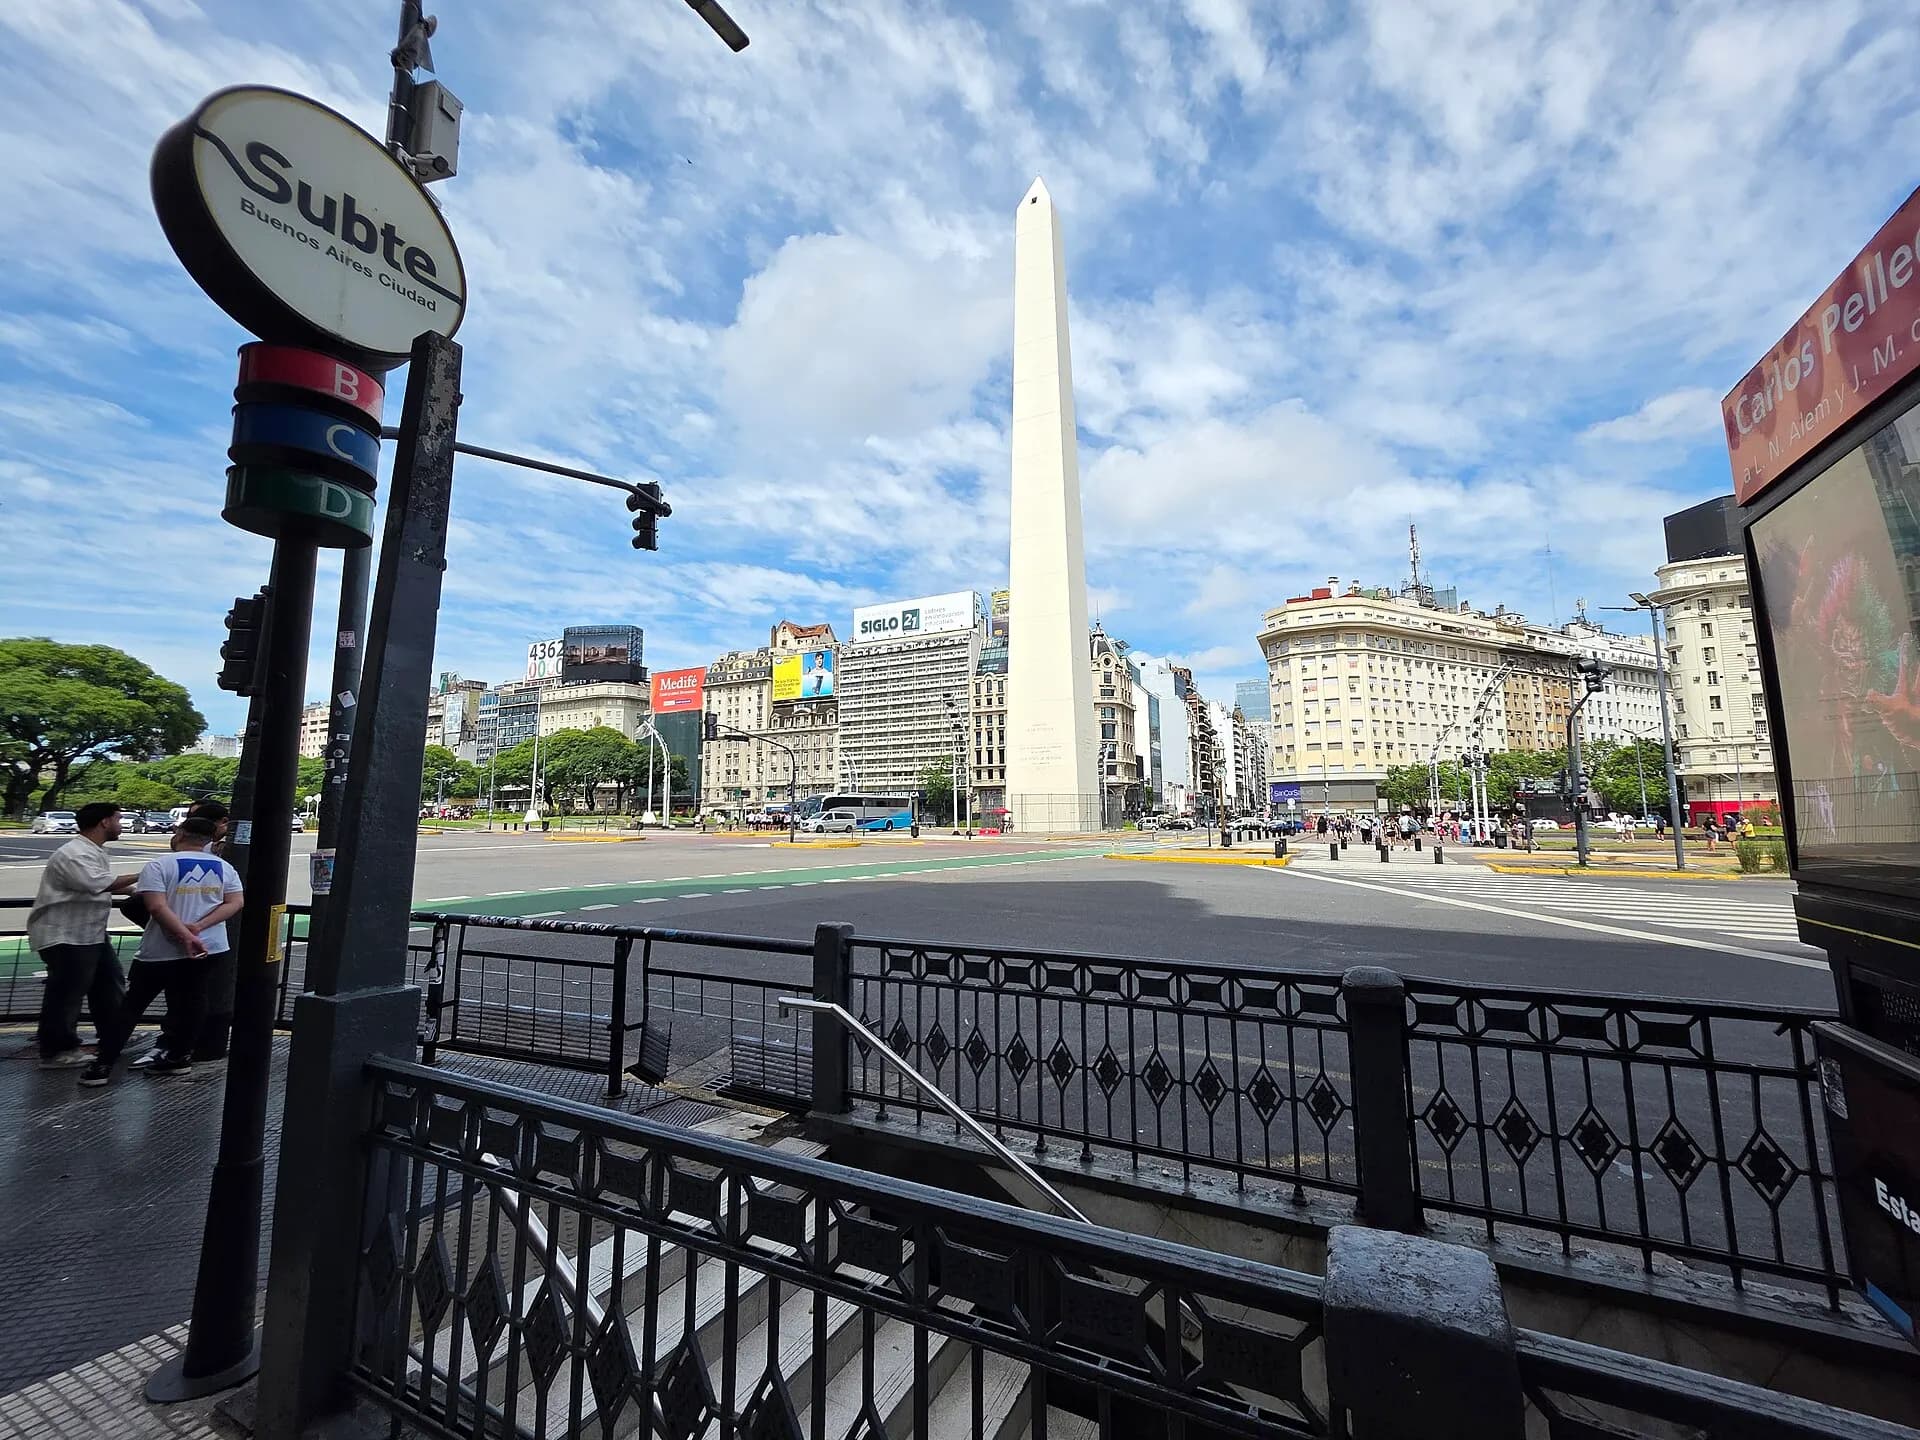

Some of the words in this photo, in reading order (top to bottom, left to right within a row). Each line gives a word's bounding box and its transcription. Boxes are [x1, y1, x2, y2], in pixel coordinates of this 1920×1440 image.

[238, 139, 441, 286] Subte
[240, 197, 319, 250] Buenos
[325, 245, 373, 279] Aires
[378, 272, 437, 312] Ciudad
[1735, 339, 1815, 435] Carlos
[1821, 226, 1920, 355] Pelle
[335, 363, 359, 401] B
[1743, 467, 1751, 484] a
[1753, 456, 1766, 474] L.
[1768, 435, 1783, 461] N.
[1789, 398, 1831, 446] Alem
[1835, 383, 1845, 412] y
[1852, 365, 1867, 393] J.
[1872, 334, 1903, 375] M.
[326, 424, 356, 461] C
[319, 480, 352, 518] D
[861, 616, 898, 634] SIGLO
[903, 613, 917, 629] 21
[660, 674, 698, 690] Medifé
